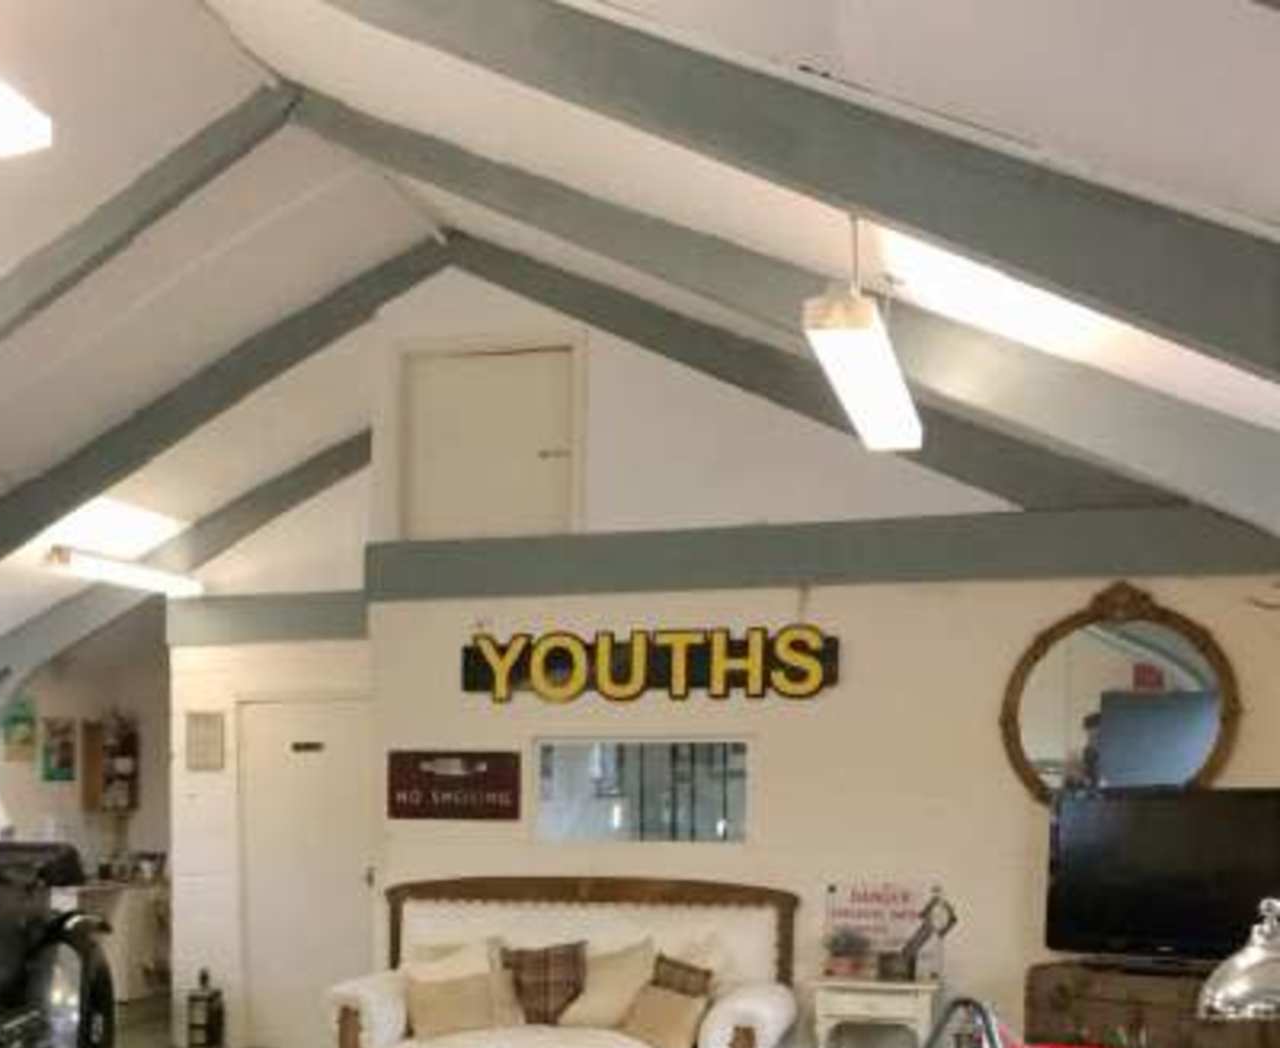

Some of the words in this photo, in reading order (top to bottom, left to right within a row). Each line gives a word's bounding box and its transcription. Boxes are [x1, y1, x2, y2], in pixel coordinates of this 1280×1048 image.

[472, 623, 826, 702] YOUTHS
[395, 791, 422, 805] NO
[430, 791, 513, 807] SMOKING
